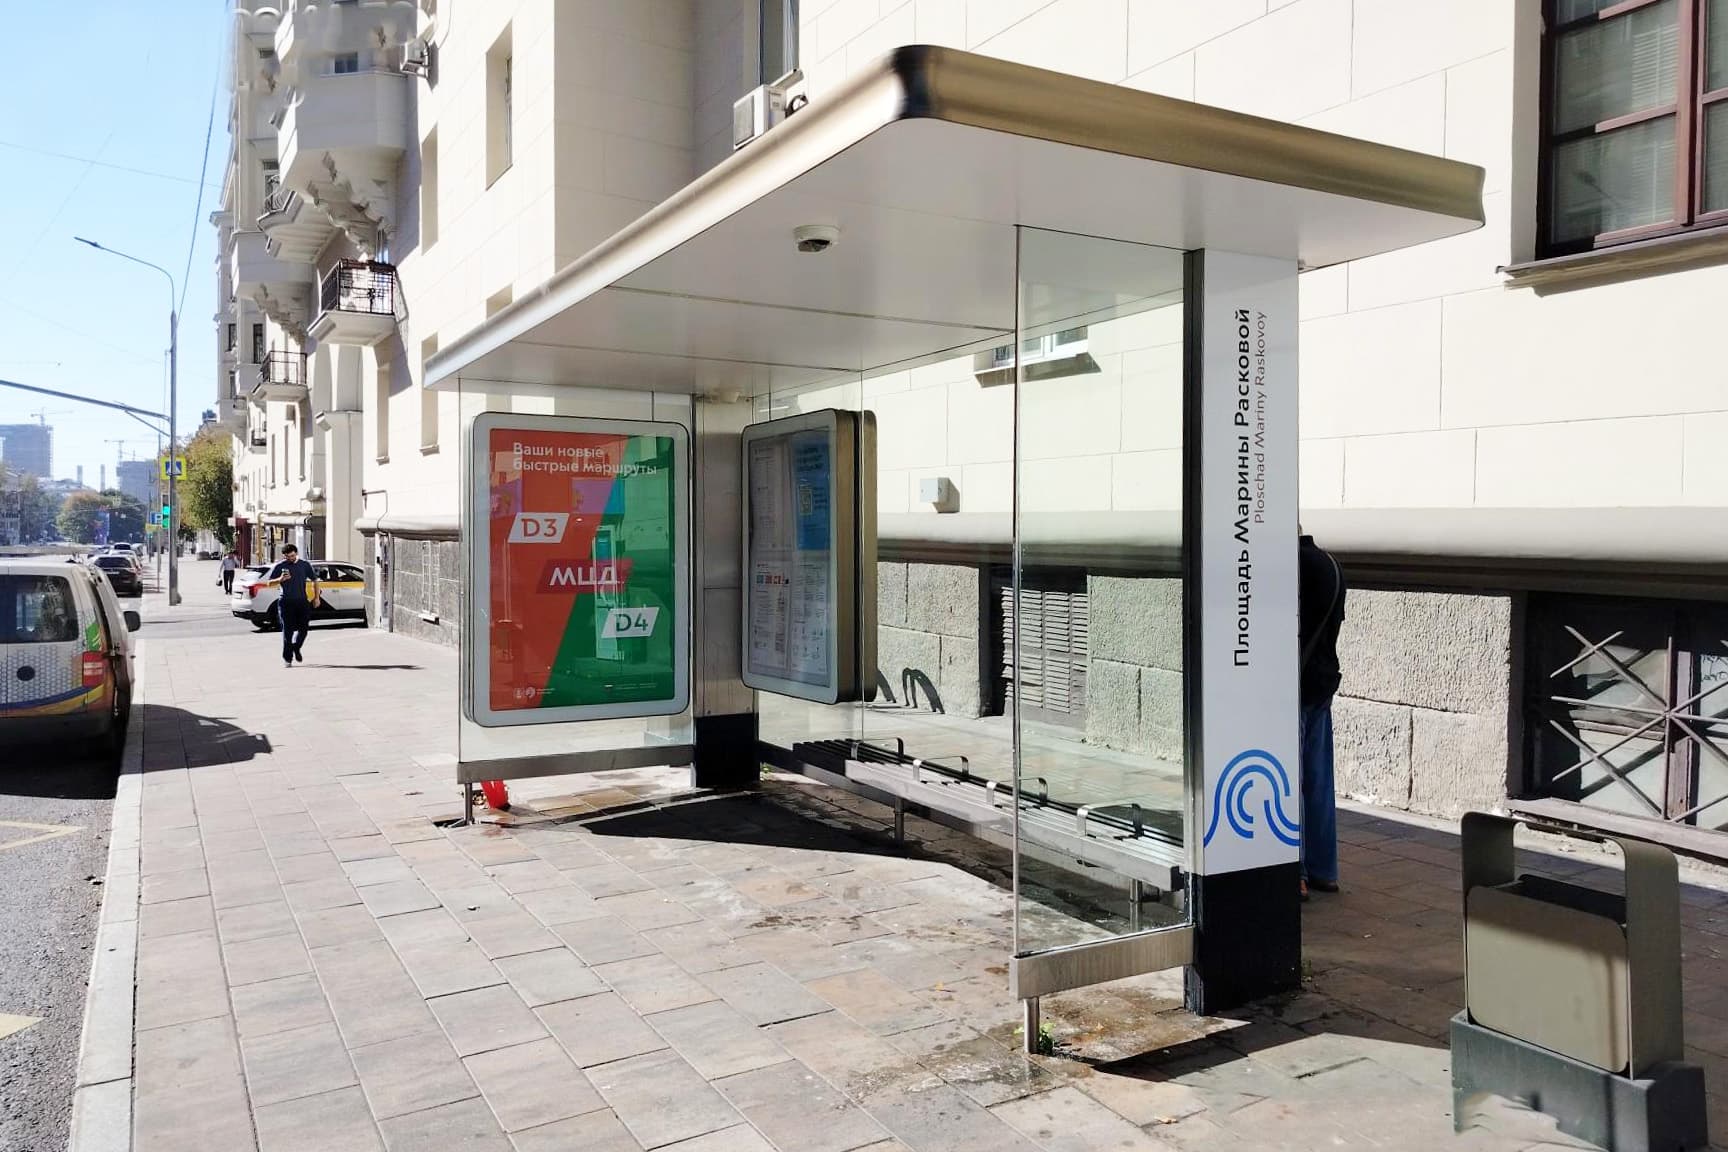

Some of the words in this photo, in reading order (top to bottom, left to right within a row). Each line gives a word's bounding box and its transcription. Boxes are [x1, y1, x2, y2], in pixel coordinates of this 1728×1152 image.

[1234, 309, 1250, 427] Расковой
[1254, 311, 1267, 386] Raskovoy
[1254, 390, 1267, 448] Mariny
[513, 442, 553, 456] Ваши
[557, 447, 604, 458] новые
[513, 457, 580, 472] быстрые
[583, 462, 657, 477] маршруты
[1234, 436, 1252, 544] Марины
[1254, 452, 1265, 524] Ploschad
[521, 518, 557, 537] D3
[549, 566, 619, 586] МЦД
[615, 612, 649, 632] D4
[1234, 549, 1252, 666] Площадь
